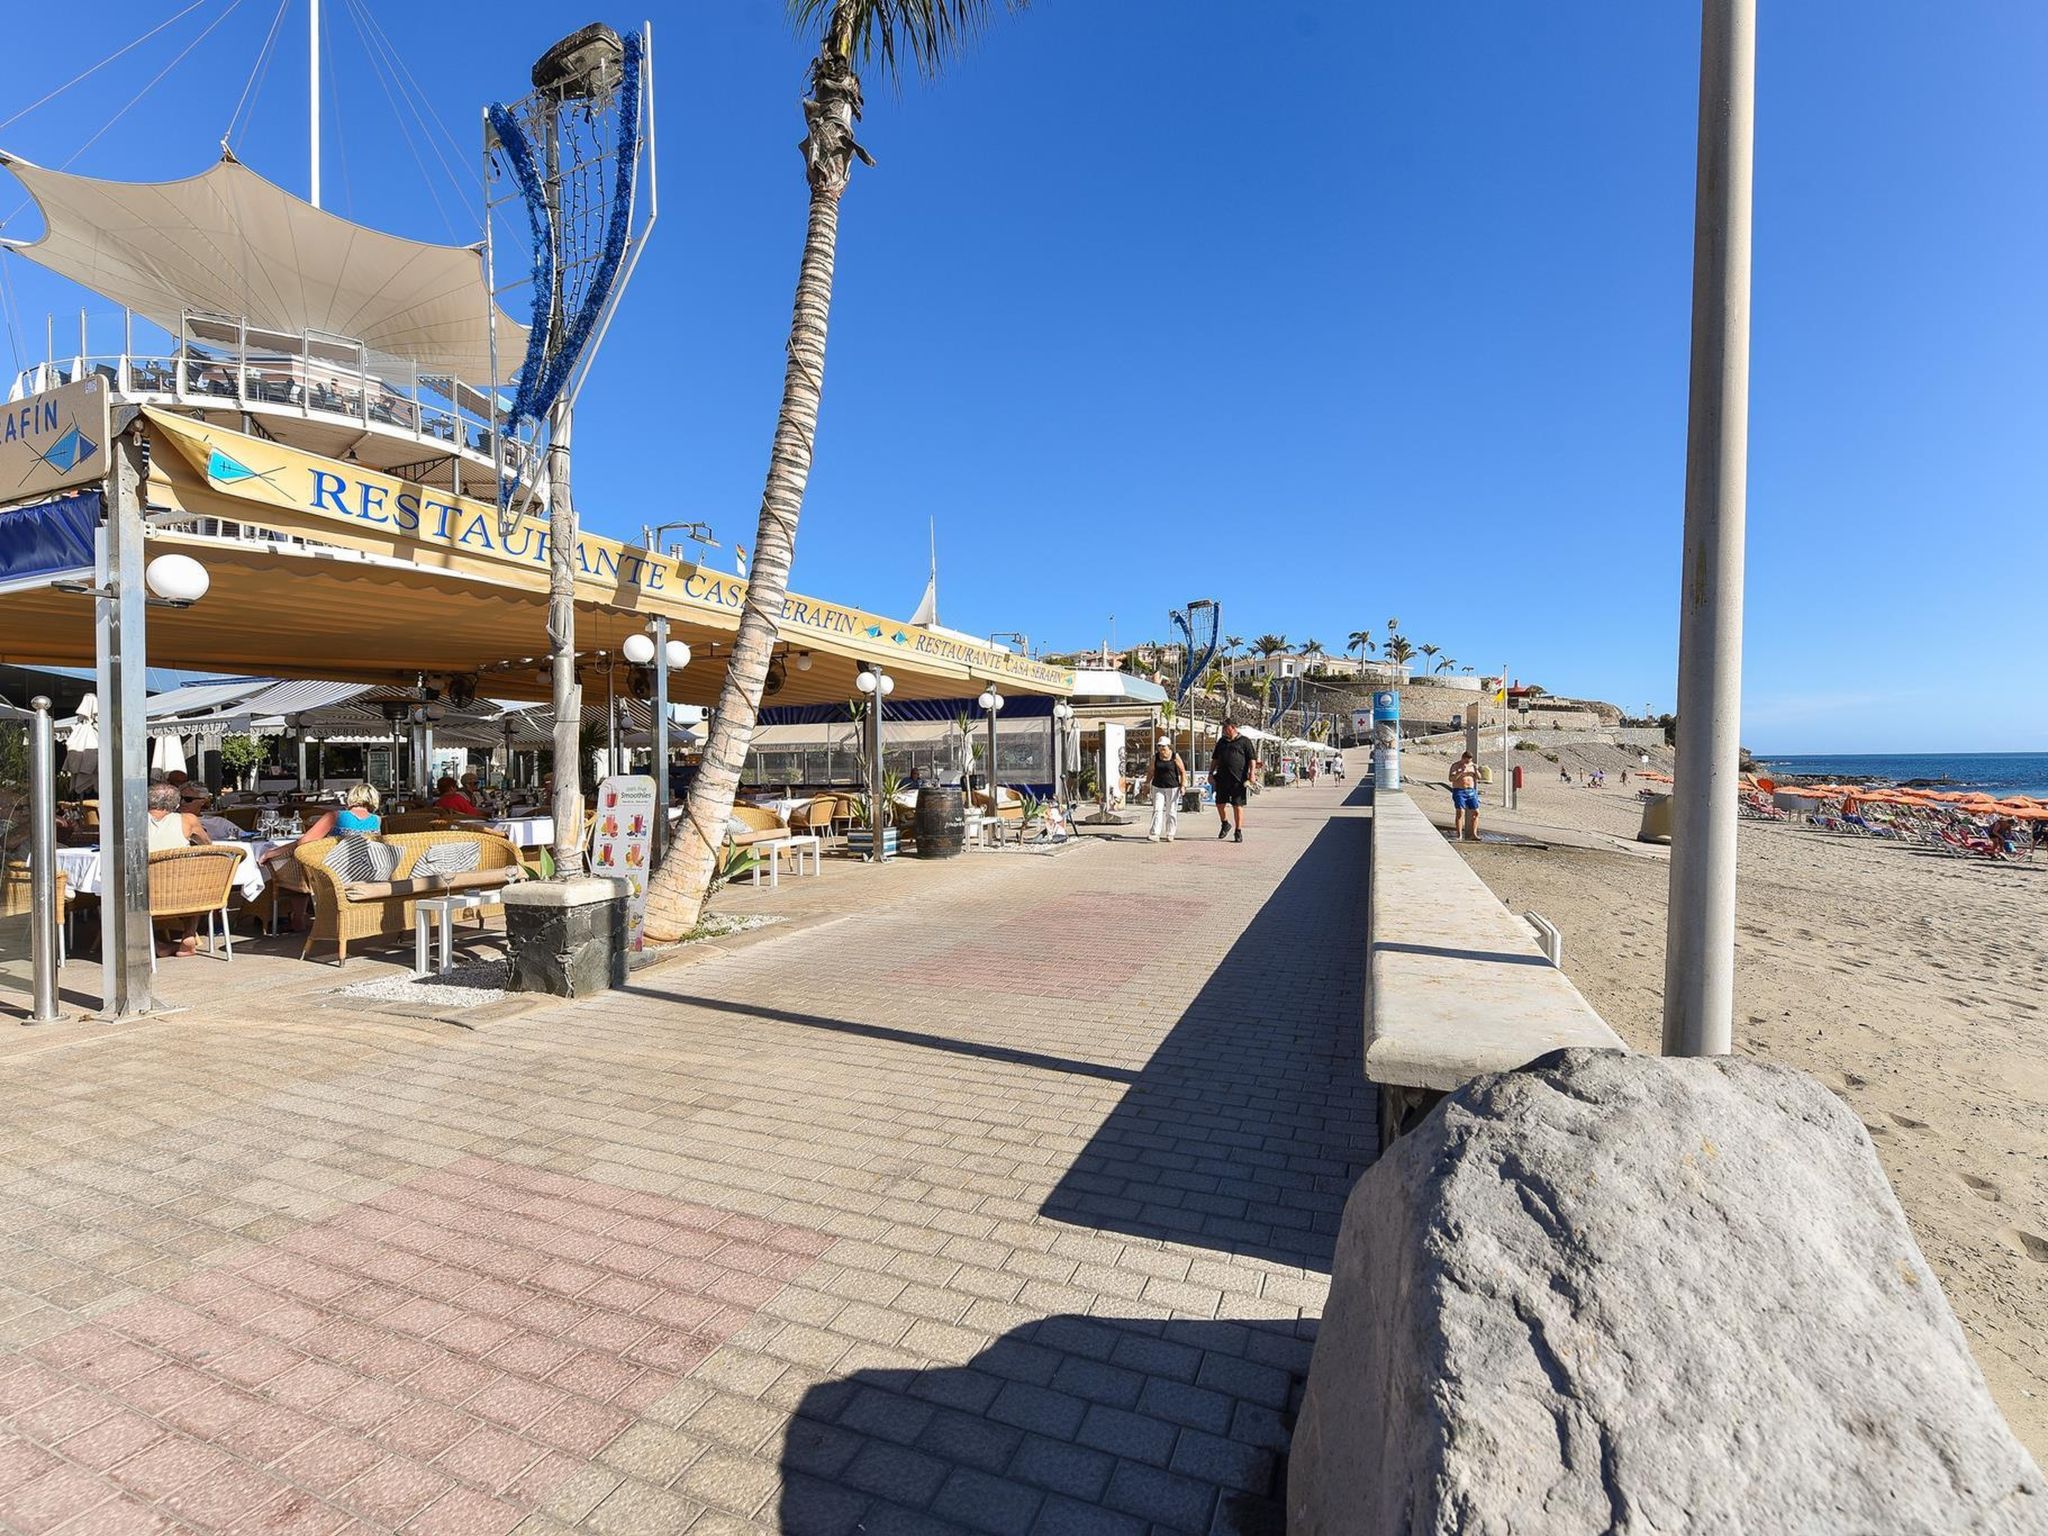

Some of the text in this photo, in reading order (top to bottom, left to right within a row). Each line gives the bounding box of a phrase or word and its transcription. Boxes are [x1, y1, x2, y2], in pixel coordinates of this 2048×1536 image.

[0, 395, 57, 445] AFÍN
[684, 574, 746, 609] CAS
[781, 599, 857, 634] ERAFIN
[915, 635, 1002, 670] RESTAURANTE
[1005, 658, 1028, 677] CASA
[152, 725, 180, 736] CASA
[621, 791, 652, 800] Smoothies
